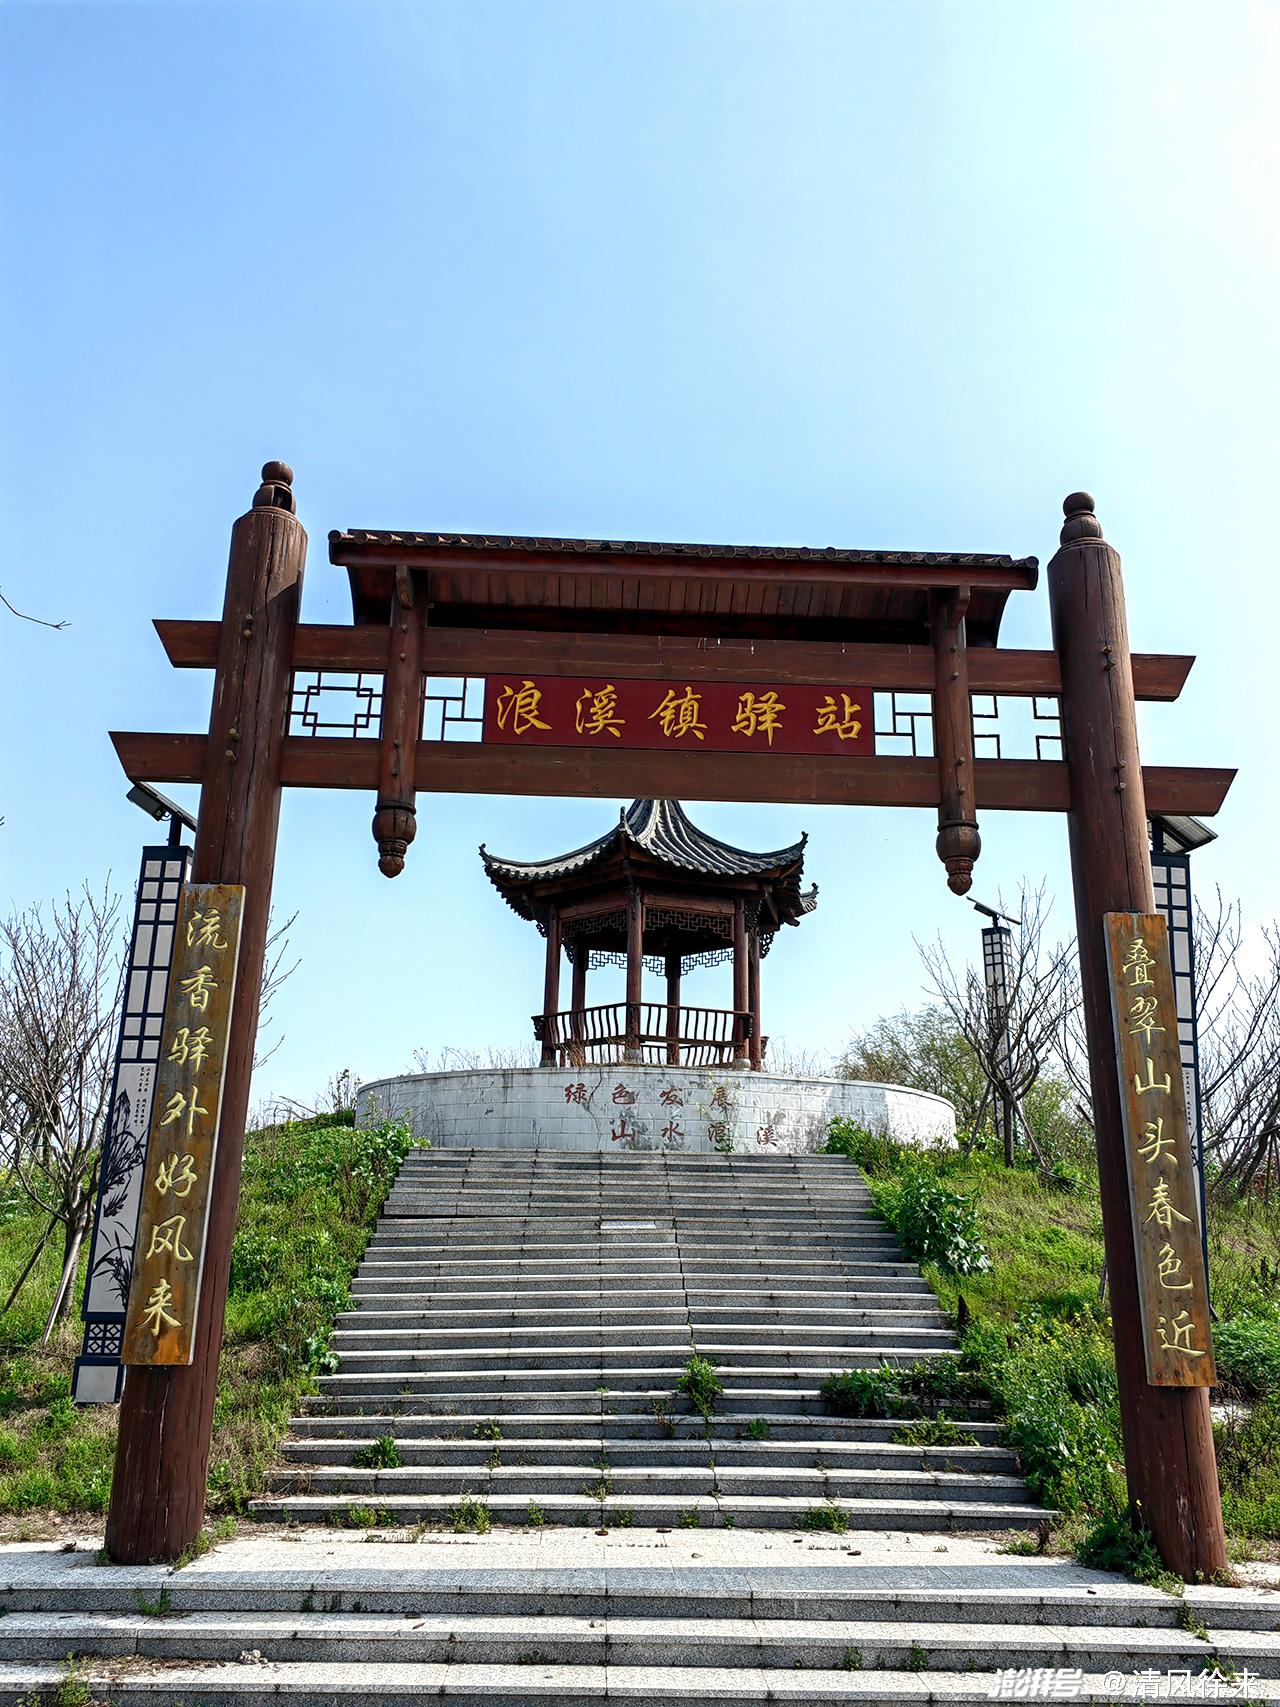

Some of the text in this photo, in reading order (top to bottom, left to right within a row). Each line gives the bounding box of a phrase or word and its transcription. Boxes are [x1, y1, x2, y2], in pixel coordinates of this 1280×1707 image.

[497, 680, 863, 747] 浪溪镇驿站
[136, 908, 229, 1337] 流香驿外好风来
[564, 1083, 733, 1108] 绿色发展
[1122, 937, 1206, 1358] 叠翠山头春色近
